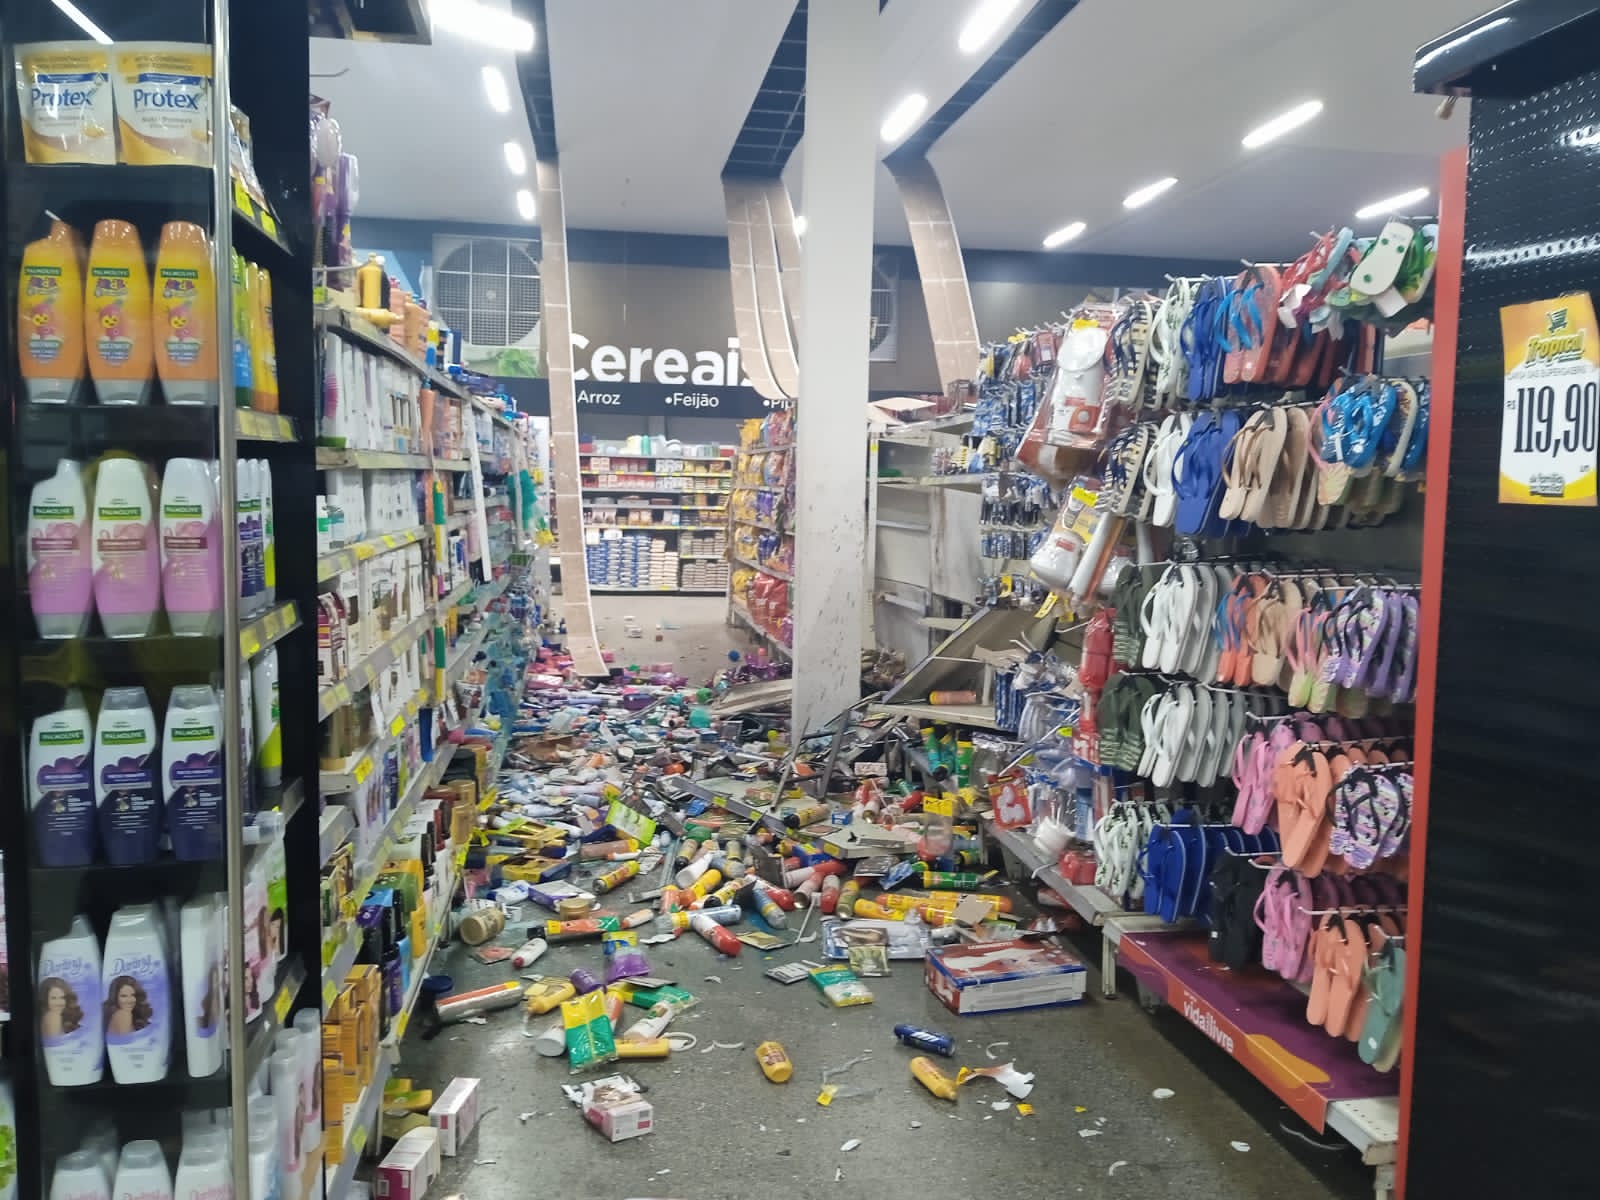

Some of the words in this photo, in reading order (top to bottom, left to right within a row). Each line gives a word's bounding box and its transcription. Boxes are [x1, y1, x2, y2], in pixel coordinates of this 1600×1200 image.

[31, 88, 93, 108] Protex
[134, 88, 199, 110] Protex
[577, 389, 621, 405] Arroz
[673, 392, 719, 409] Feijão
[1513, 382, 1597, 458] 119,90
